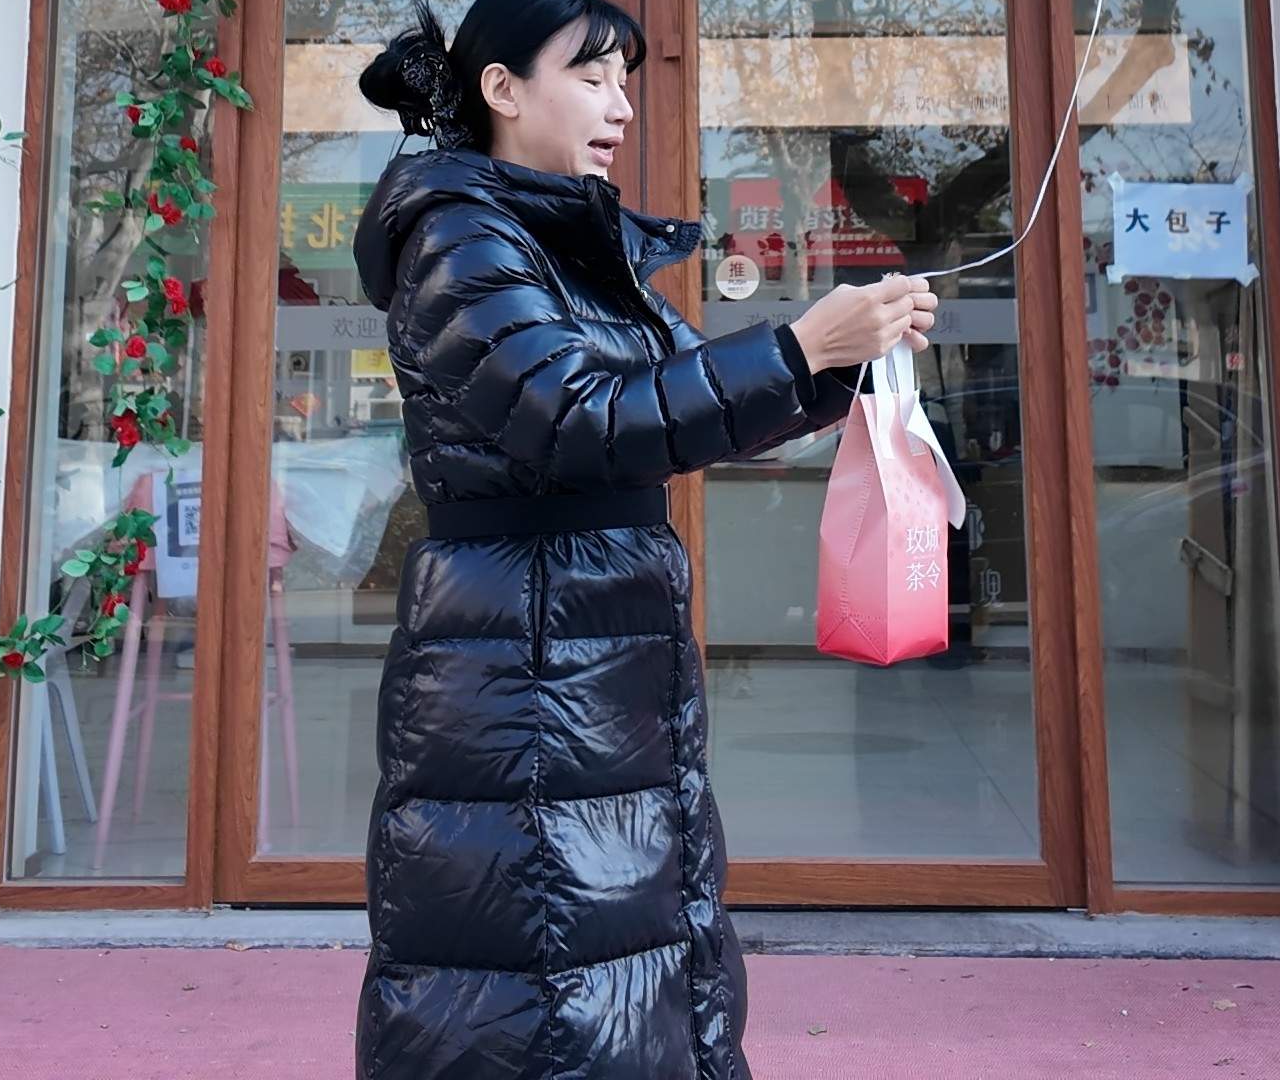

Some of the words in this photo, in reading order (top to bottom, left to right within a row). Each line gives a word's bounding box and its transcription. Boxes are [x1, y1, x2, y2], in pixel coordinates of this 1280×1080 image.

[1125, 207, 1231, 234] 大包子
[906, 560, 941, 591] 茶令
